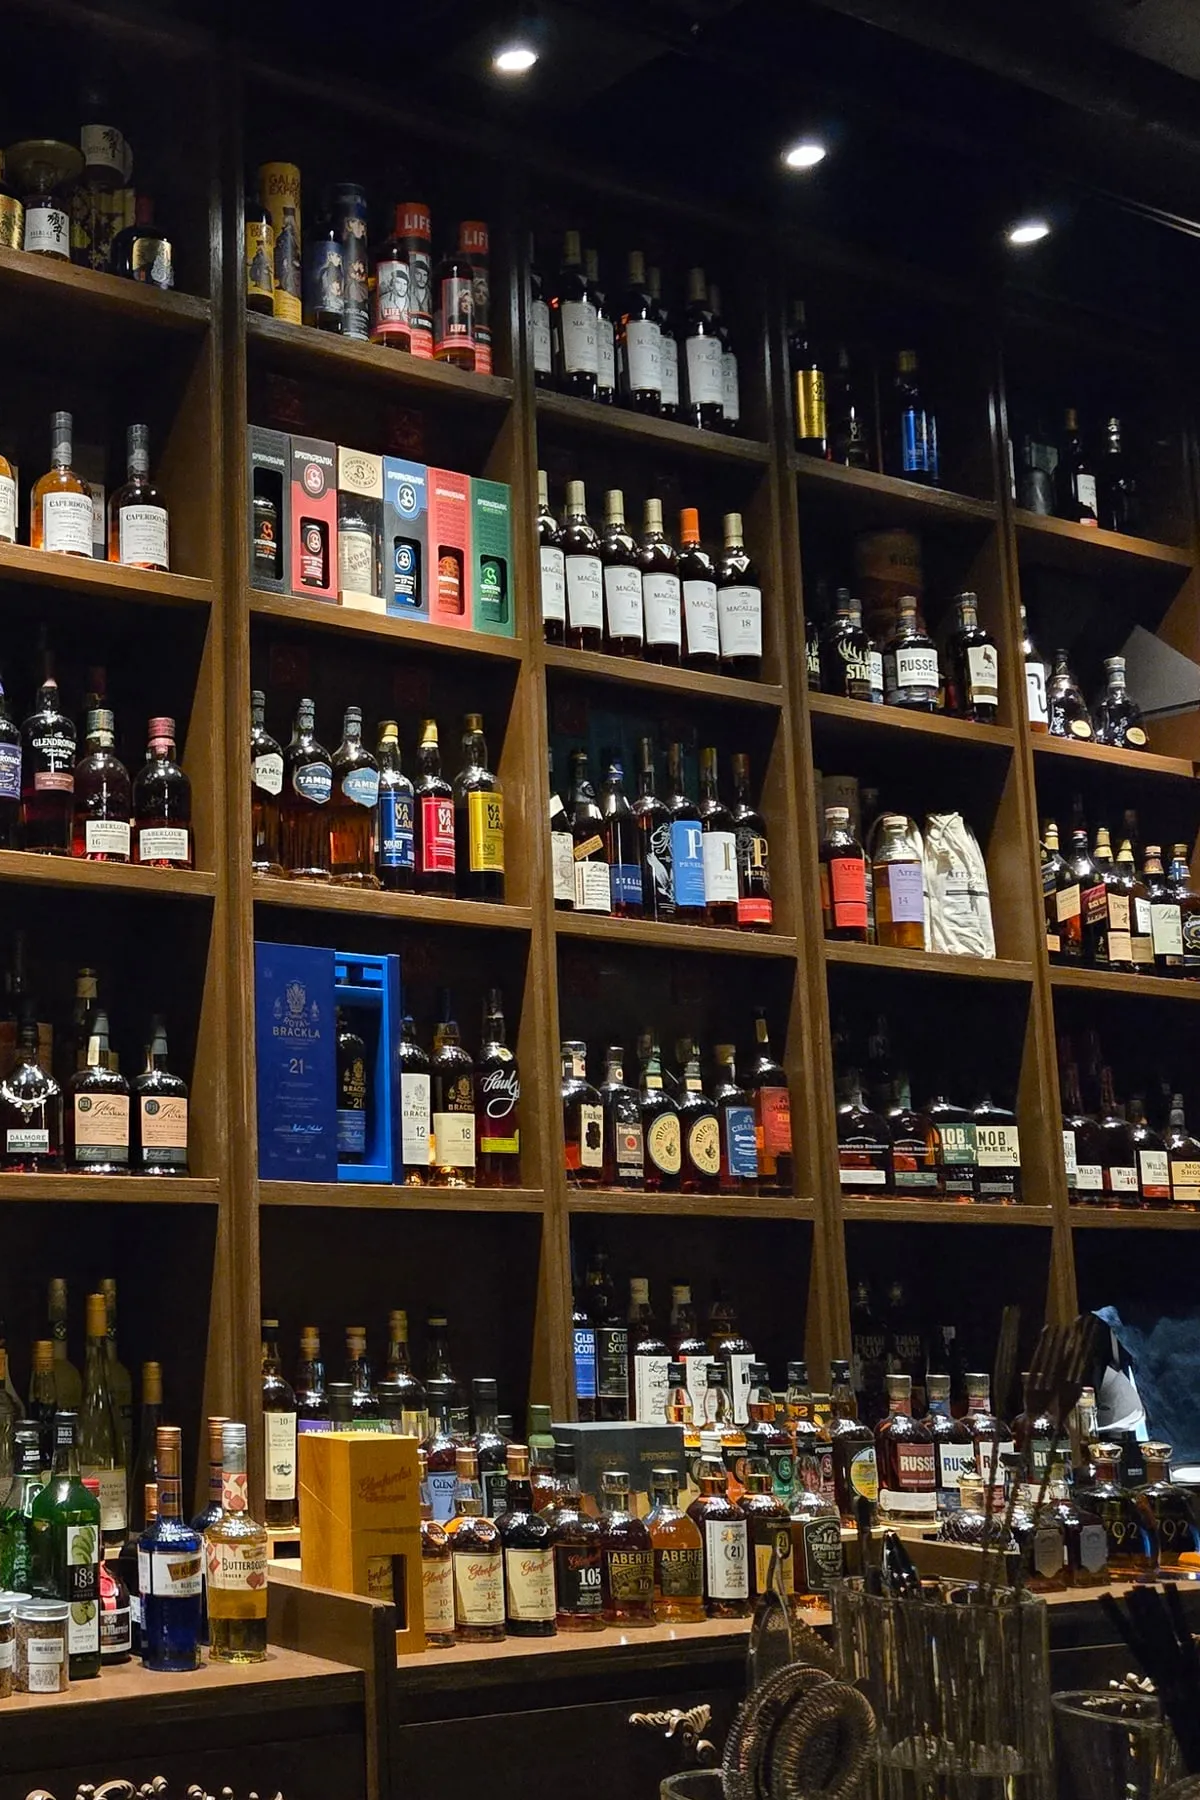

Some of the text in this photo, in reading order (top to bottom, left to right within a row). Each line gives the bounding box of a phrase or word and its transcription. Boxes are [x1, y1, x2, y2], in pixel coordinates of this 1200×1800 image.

[404, 214, 431, 233] LIFE
[591, 590, 598, 599] 18
[630, 600, 638, 608] 18
[668, 608, 676, 616] 18
[741, 620, 752, 628] 18
[395, 803, 408, 813] KA
[438, 808, 452, 818] KA
[486, 804, 500, 813] KA
[395, 812, 409, 821] VA
[438, 816, 452, 826] VA
[487, 812, 500, 821] VA
[752, 837, 769, 868] P
[283, 1016, 310, 1028] ROYAL
[272, 1026, 321, 1038] BRACKLA
[289, 1058, 304, 1075] 21
[416, 1126, 426, 1138] 12
[461, 1128, 472, 1140] 18
[978, 1131, 1006, 1146] NOB
[1012, 1152, 1018, 1162] 9
[1126, 1176, 1136, 1185] 10
[578, 1568, 602, 1586] 105
[486, 1592, 496, 1600] 12
[539, 1588, 548, 1596] 15
[439, 1599, 448, 1607] 10
